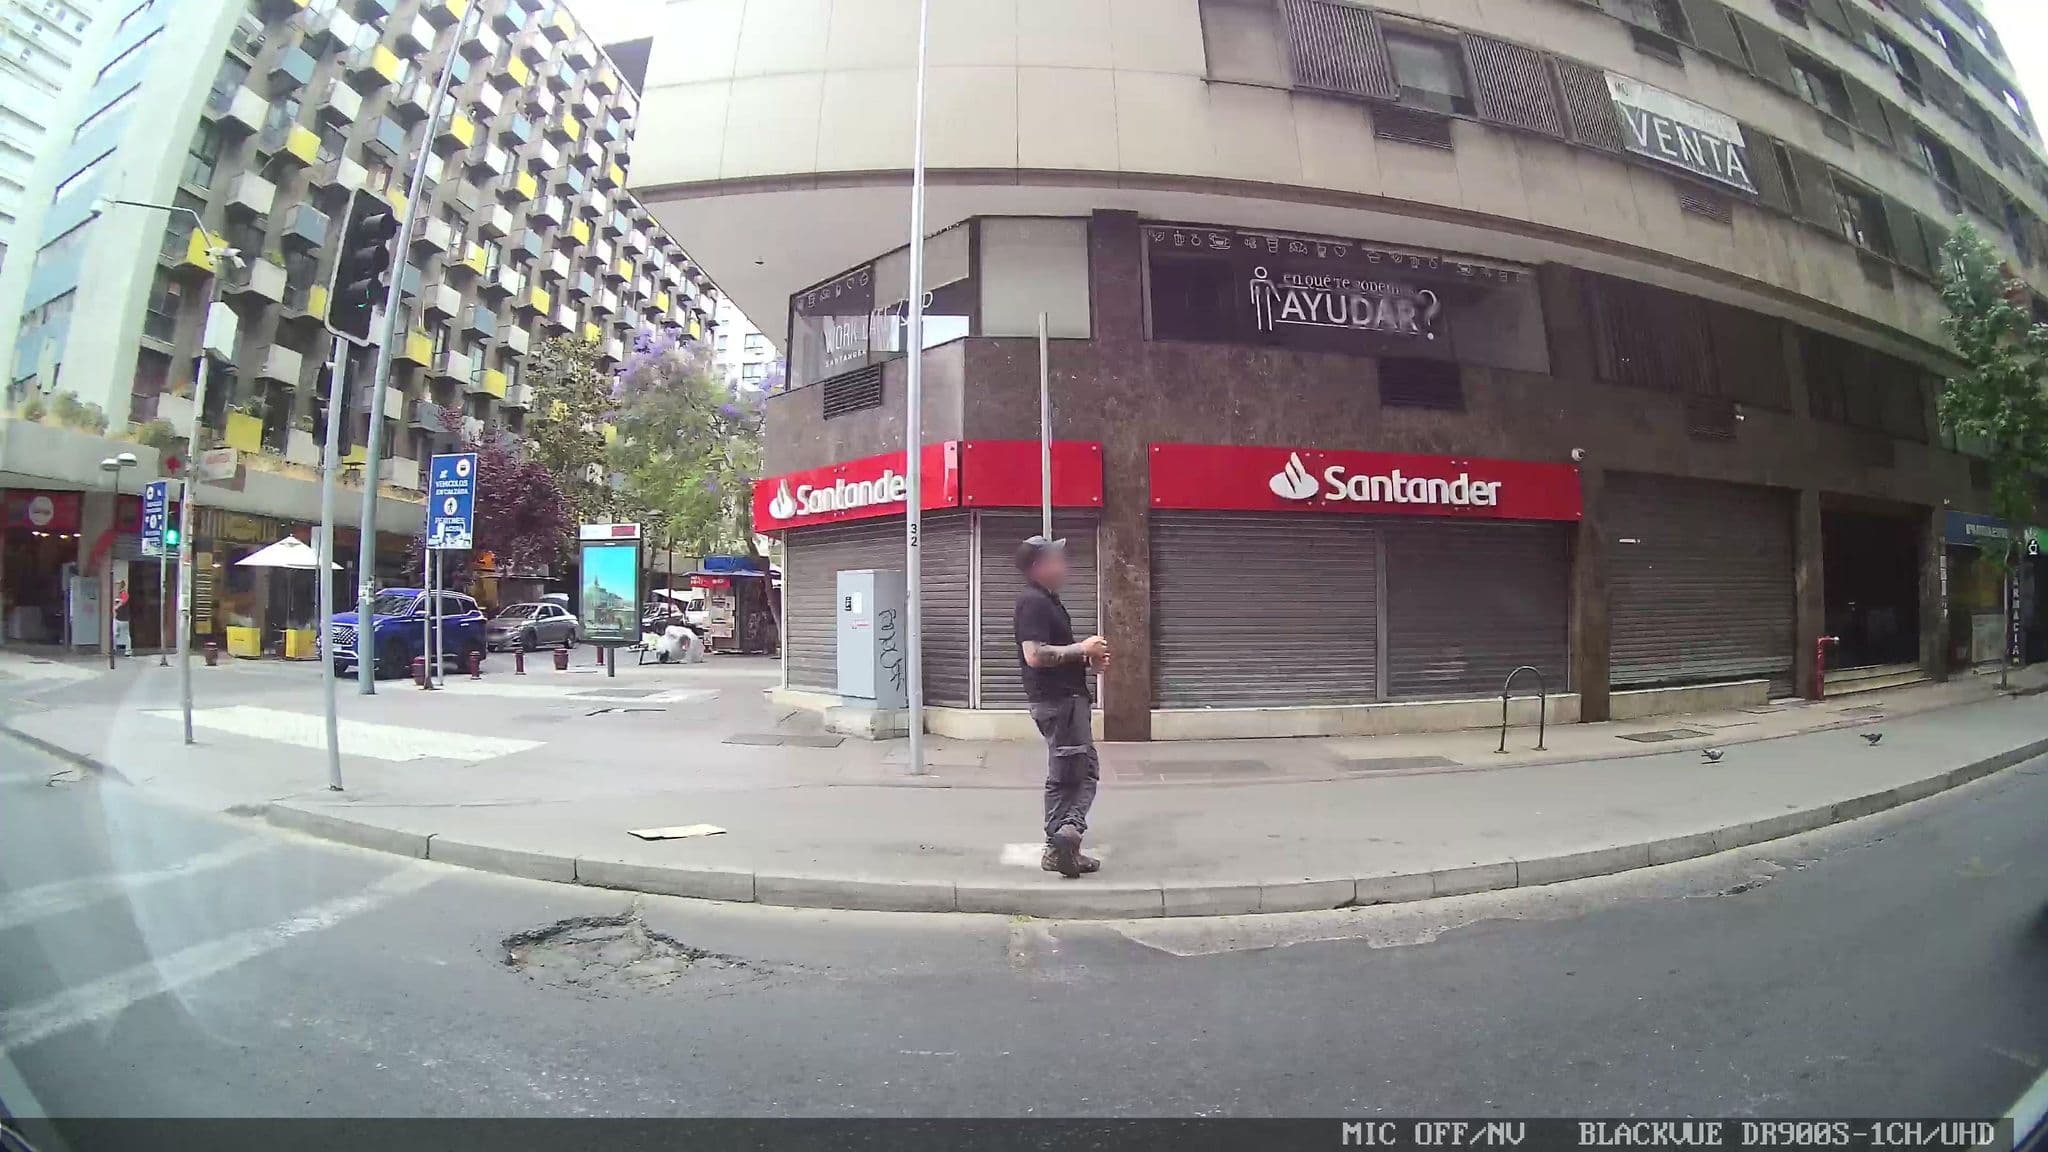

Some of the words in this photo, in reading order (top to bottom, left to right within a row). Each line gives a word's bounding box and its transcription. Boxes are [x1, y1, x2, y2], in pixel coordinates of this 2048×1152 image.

[1619, 104, 1750, 184] VENTA
[823, 316, 859, 354] WORK
[796, 469, 907, 516] Santande
[1323, 465, 1502, 506] Santander
